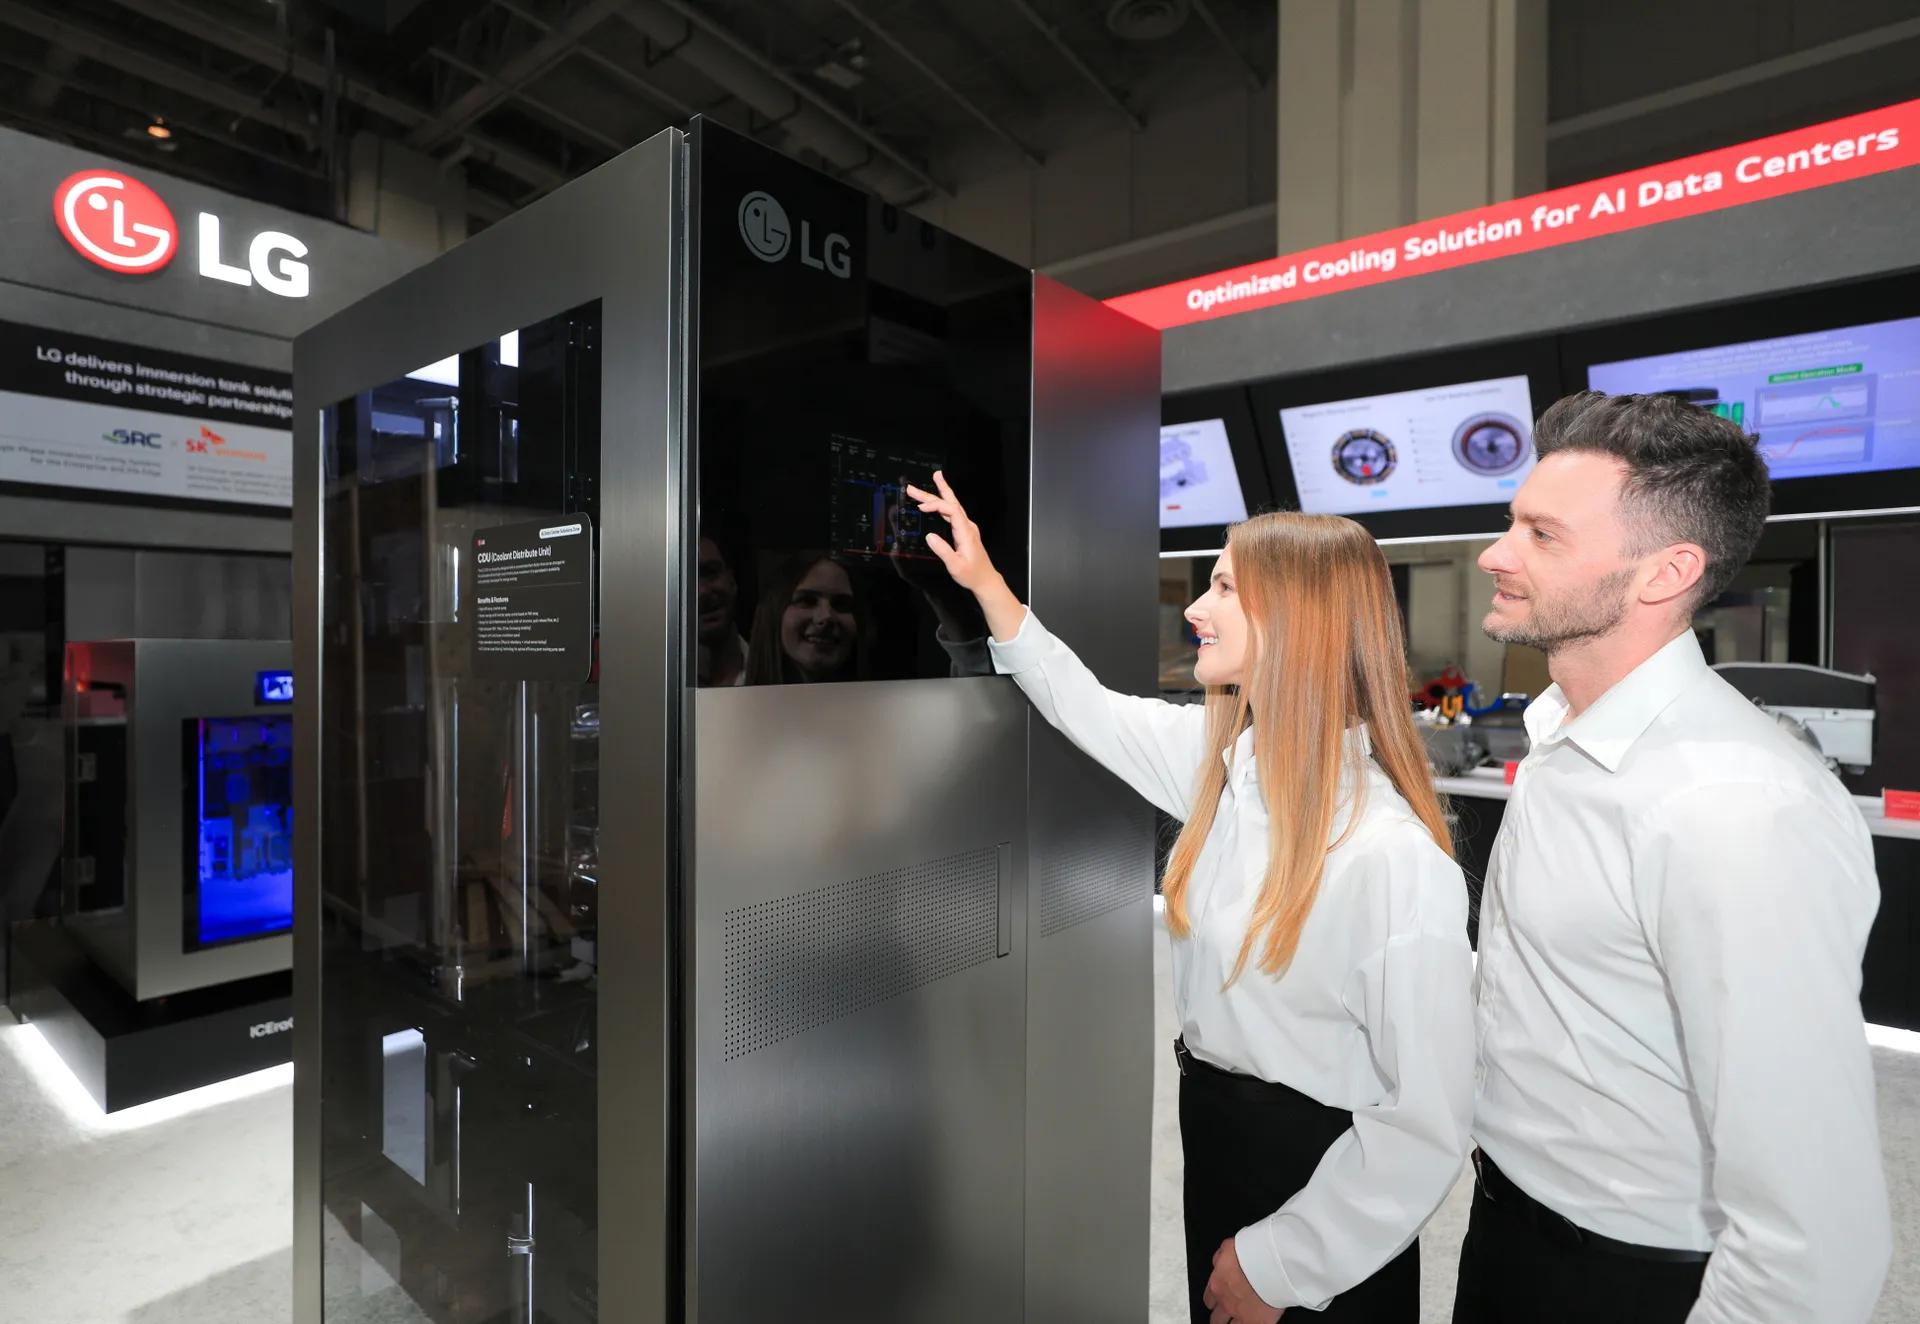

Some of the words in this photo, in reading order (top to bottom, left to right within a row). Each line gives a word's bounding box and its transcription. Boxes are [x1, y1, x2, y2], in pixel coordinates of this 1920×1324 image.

[1186, 267, 1296, 311] Optimized
[1303, 247, 1397, 284] Cooling
[1404, 217, 1522, 261] Solution
[1531, 204, 1580, 232] for
[1589, 188, 1625, 220] AI
[1638, 169, 1723, 207] Data
[1735, 127, 1900, 184] Centers
[198, 211, 310, 298] LG
[801, 220, 851, 279] LG
[36, 346, 62, 364] LG
[65, 352, 133, 375] delivers
[136, 363, 216, 389] immersion
[218, 377, 251, 395] tank
[253, 385, 293, 401] soluti
[65, 370, 133, 394] through
[135, 382, 206, 406] strategic
[477, 552, 491, 564] CDU
[491, 551, 512, 562] (Coolant
[513, 549, 537, 560] Distribute
[538, 545, 551, 557] Unit)
